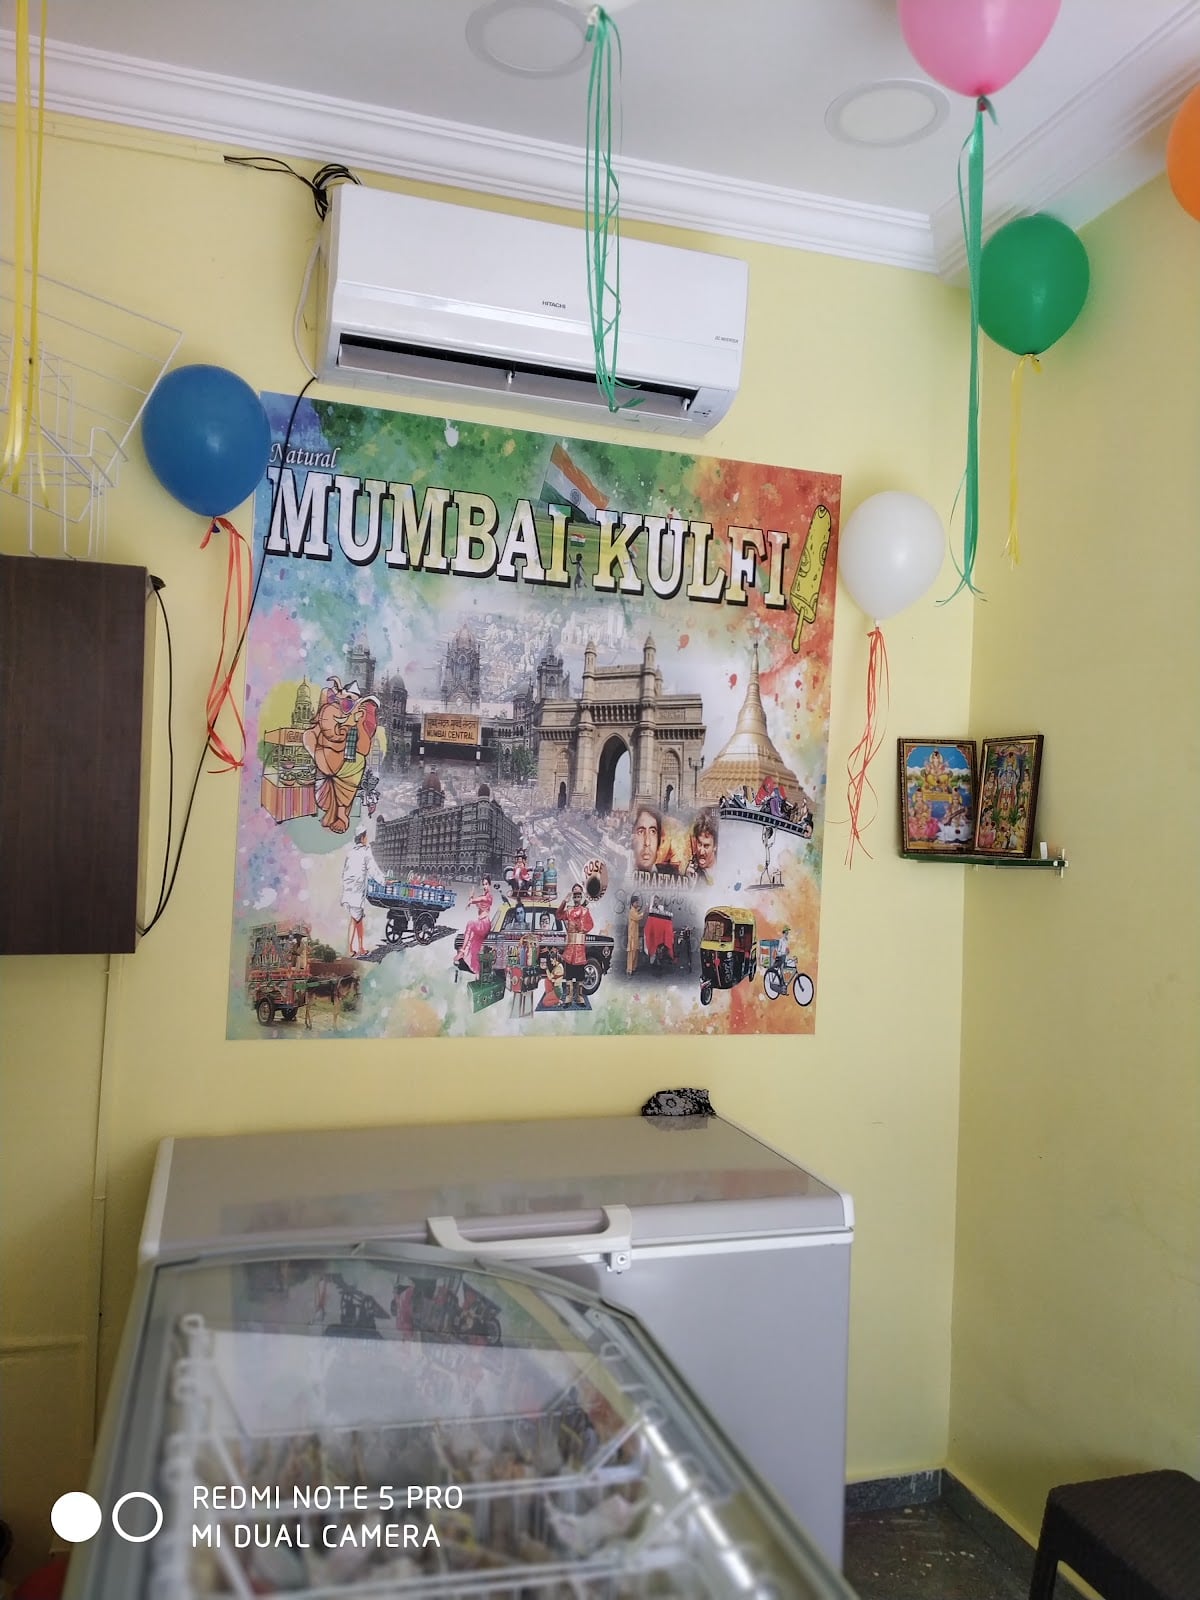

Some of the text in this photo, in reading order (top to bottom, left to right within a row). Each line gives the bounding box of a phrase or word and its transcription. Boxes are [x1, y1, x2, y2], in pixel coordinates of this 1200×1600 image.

[542, 300, 566, 309] HITACHI
[269, 443, 341, 469] Natural
[264, 466, 790, 611] MUMBAI KULFI
[448, 730, 475, 740] CENTRAL
